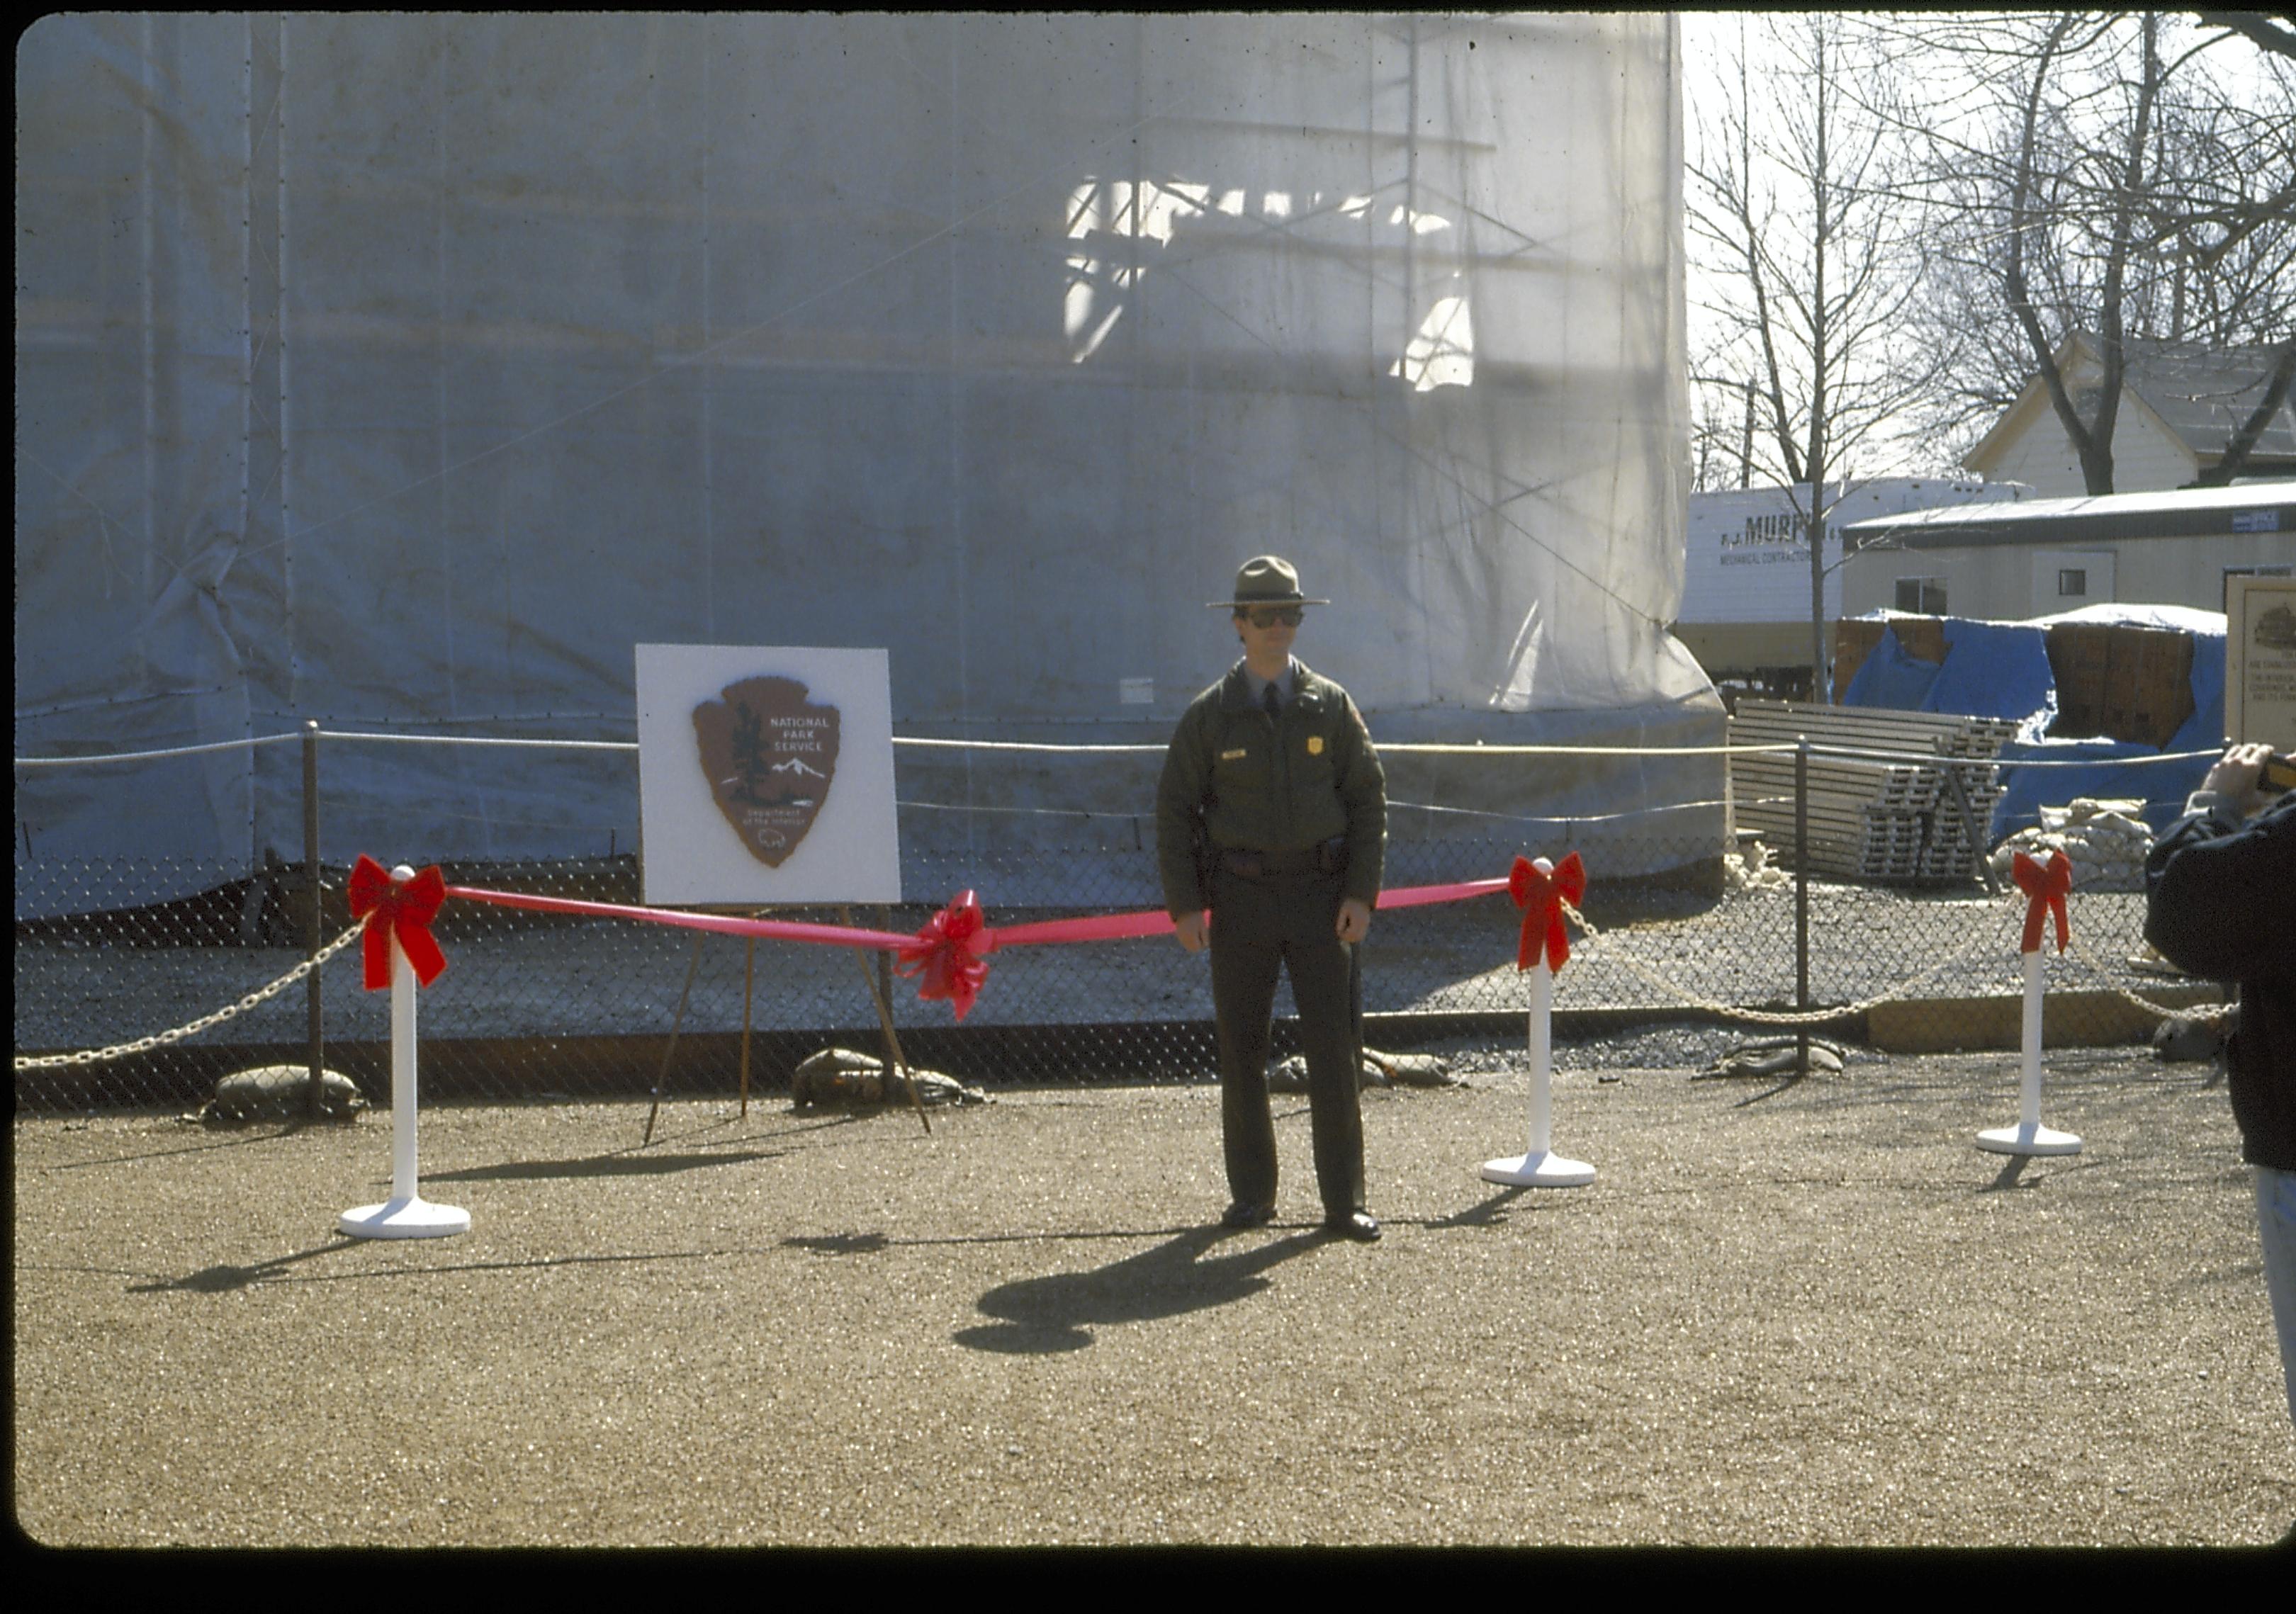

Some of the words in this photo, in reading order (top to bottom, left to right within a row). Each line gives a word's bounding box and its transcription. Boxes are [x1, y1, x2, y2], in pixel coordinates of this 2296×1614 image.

[770, 718, 830, 728] NATIONAL
[783, 730, 814, 739] PARK
[775, 742, 822, 752] SERVICE
